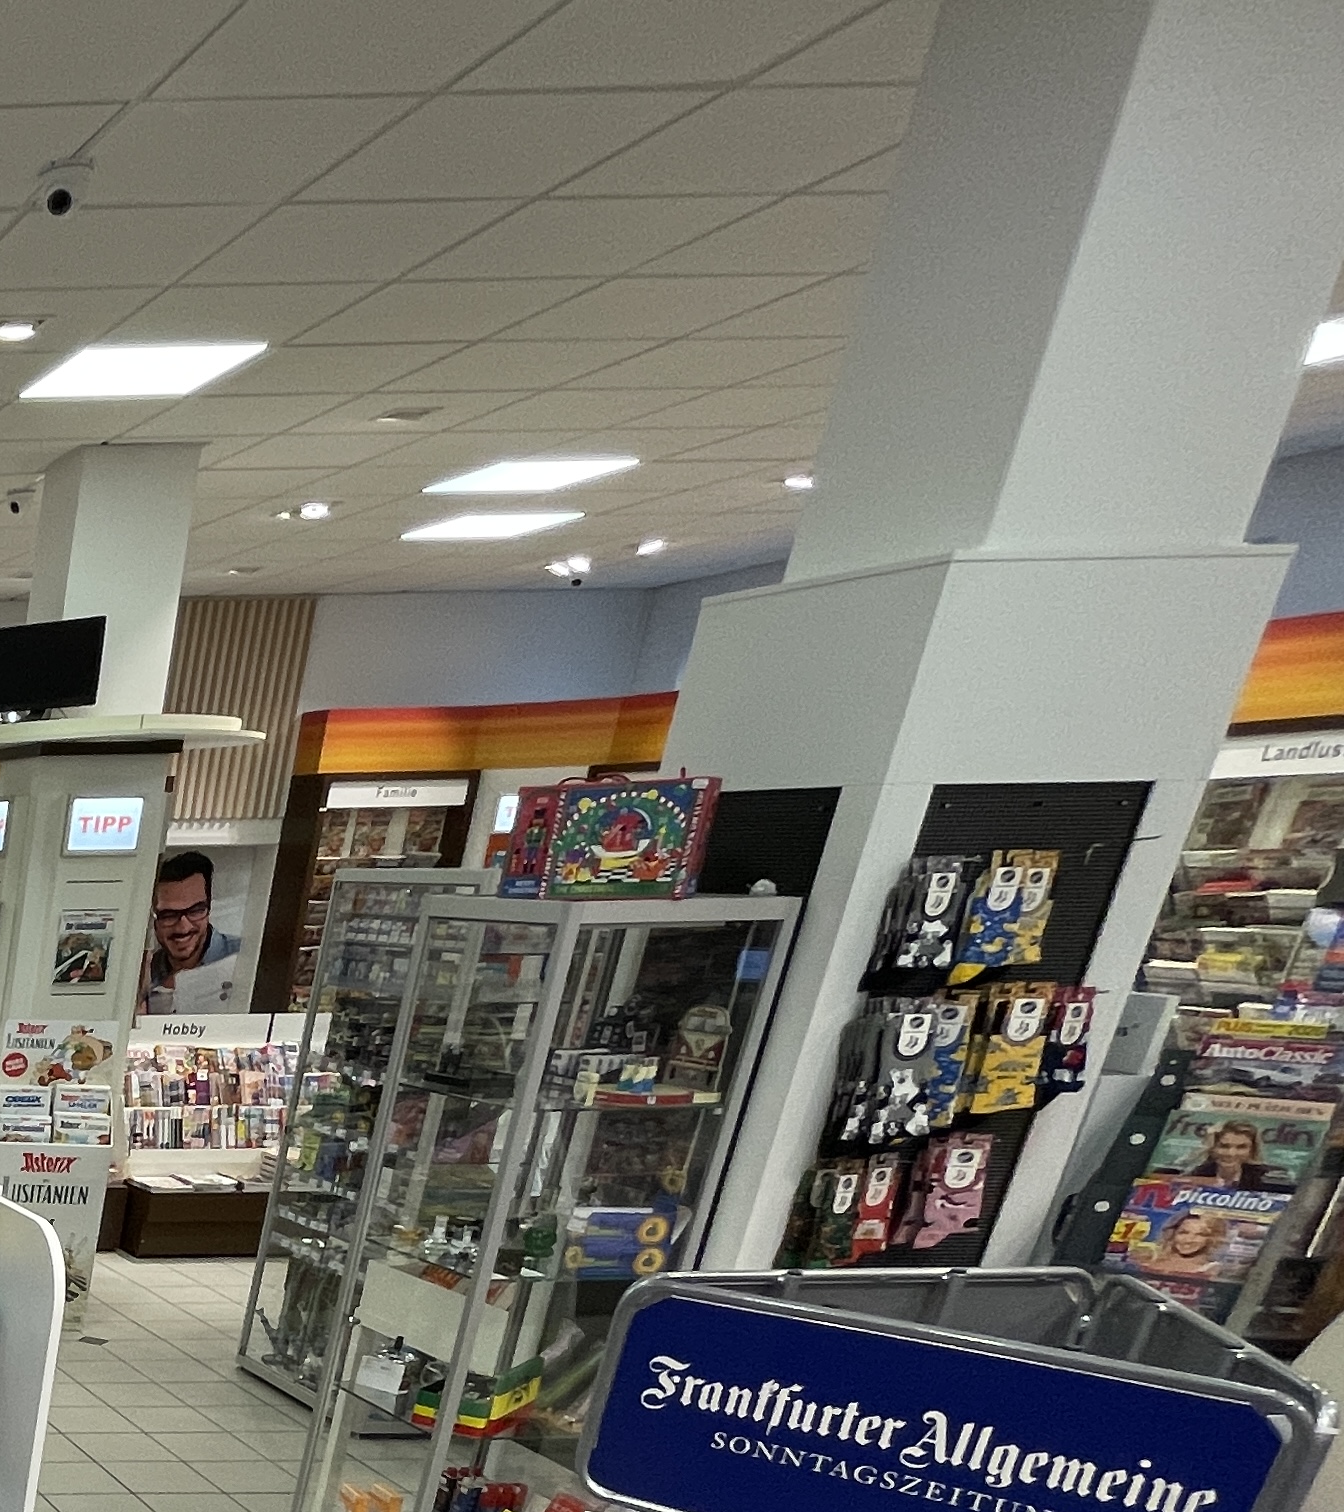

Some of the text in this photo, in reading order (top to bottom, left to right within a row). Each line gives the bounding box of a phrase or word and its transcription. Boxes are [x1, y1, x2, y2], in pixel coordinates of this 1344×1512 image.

[376, 786, 418, 799] Familie
[78, 814, 133, 834] TIPP
[161, 1021, 207, 1038] Hobby
[20, 1151, 79, 1174] Asterix
[1172, 1187, 1274, 1212] piccolino
[640, 1353, 908, 1453] Frankfurter
